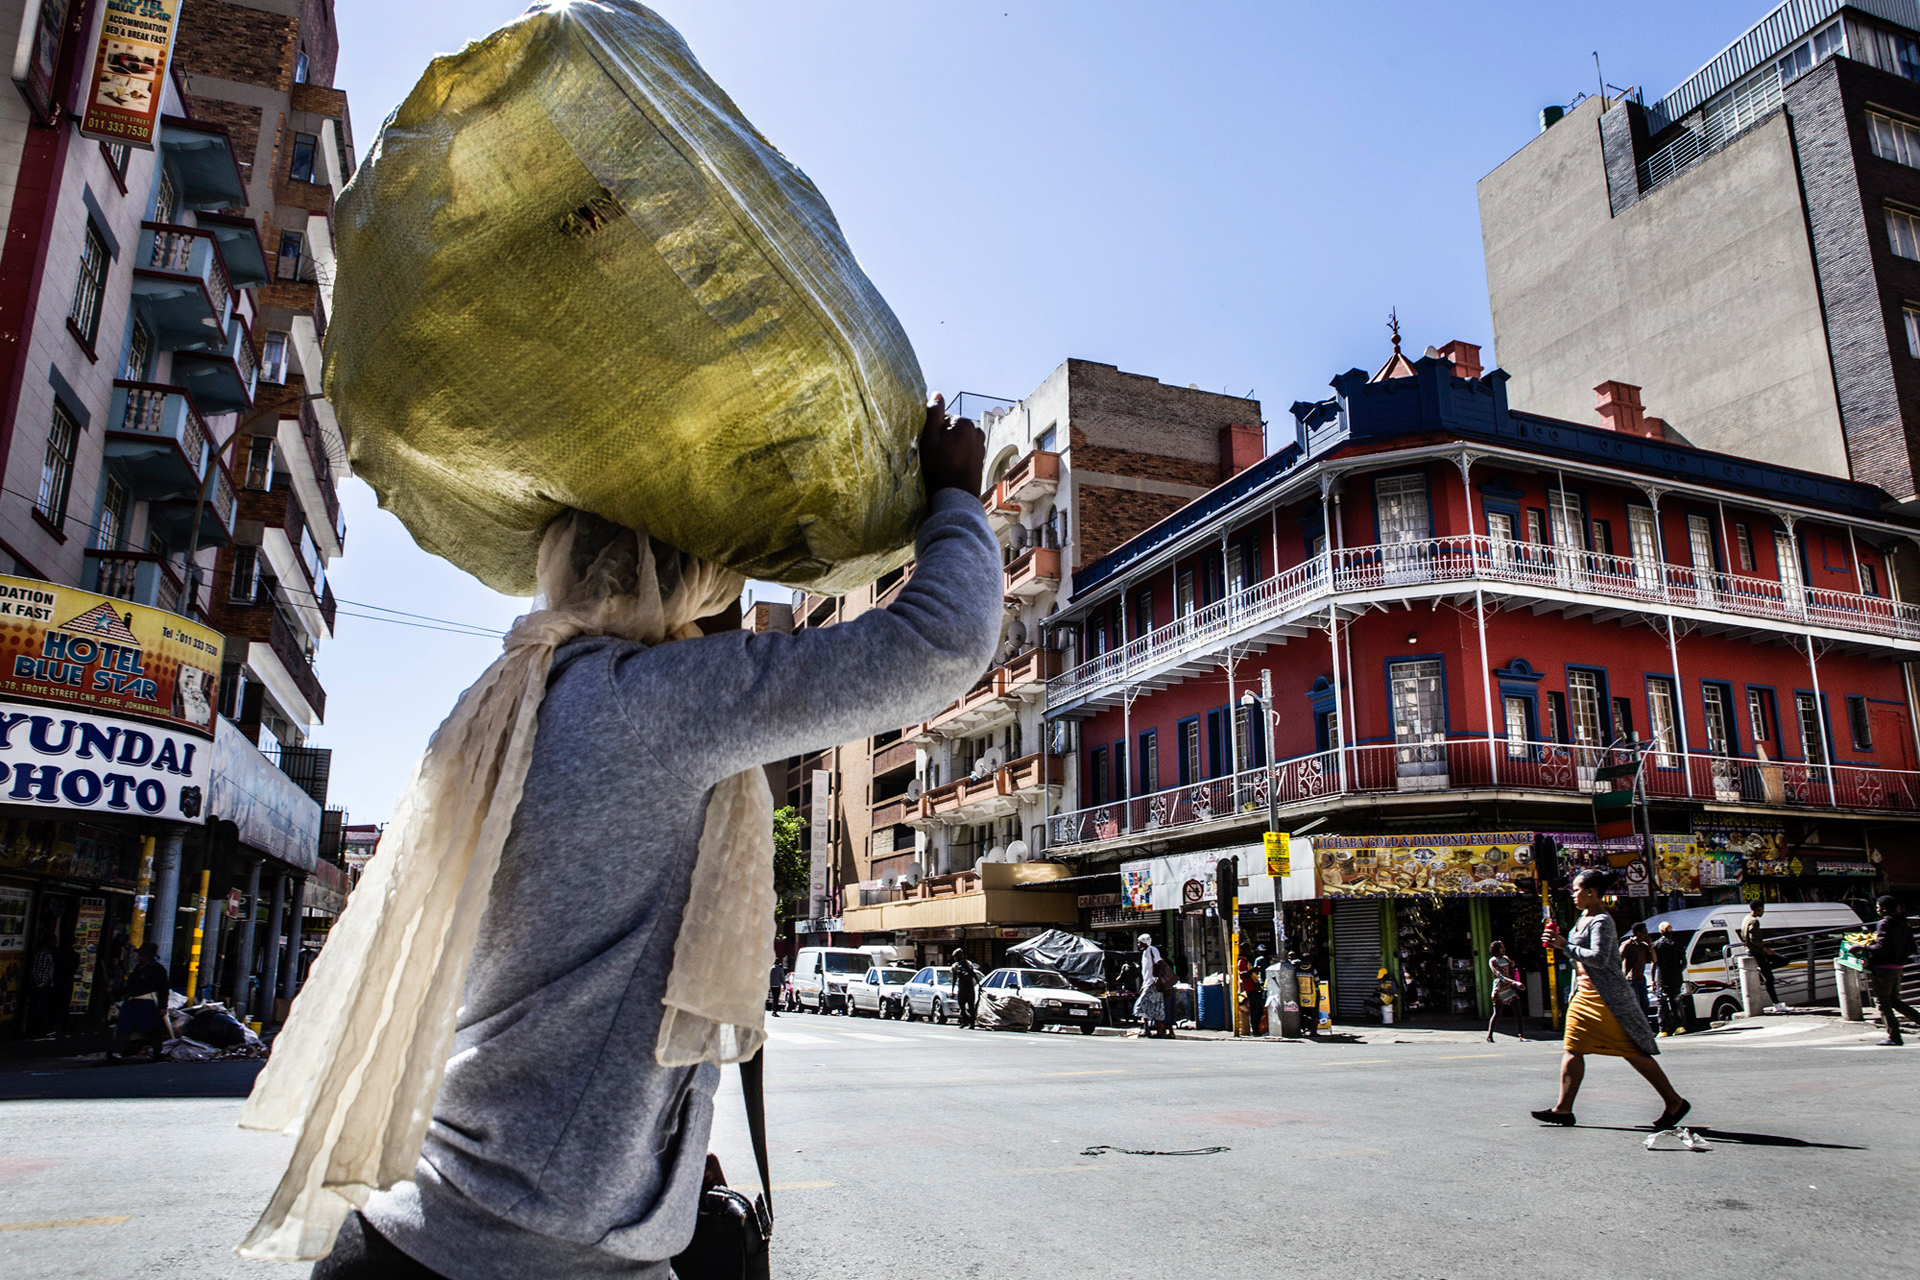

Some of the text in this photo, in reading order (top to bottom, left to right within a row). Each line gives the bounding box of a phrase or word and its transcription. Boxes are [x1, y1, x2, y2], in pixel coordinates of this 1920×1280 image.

[107, 1, 172, 22] BLUE STAR
[105, 24, 167, 45] BED & BREAK FAST
[108, 14, 168, 34] ACCOMMODATION
[88, 117, 149, 138] 011 333 7530
[16, 604, 52, 621] FAST
[162, 626, 174, 639] Tel
[193, 637, 205, 651] 333
[42, 629, 145, 677] HOTEL
[13, 654, 158, 702] BLUE STAR
[21, 683, 48, 695] TROYE
[49, 688, 79, 701] STREET
[124, 701, 171, 717] JOHANNESBURG
[814, 772, 827, 863] DISCOUNT
[1692, 813, 1710, 825] GOLD
[1719, 814, 1749, 827] DIAMOND
[1316, 836, 1365, 850] LICHABA
[1367, 835, 1399, 848] GOLD
[1401, 835, 1410, 847] &
[1413, 833, 1467, 848] DIAMOND
[1470, 832, 1535, 845] EXCHANGE
[1079, 894, 1111, 907] CRACKER
